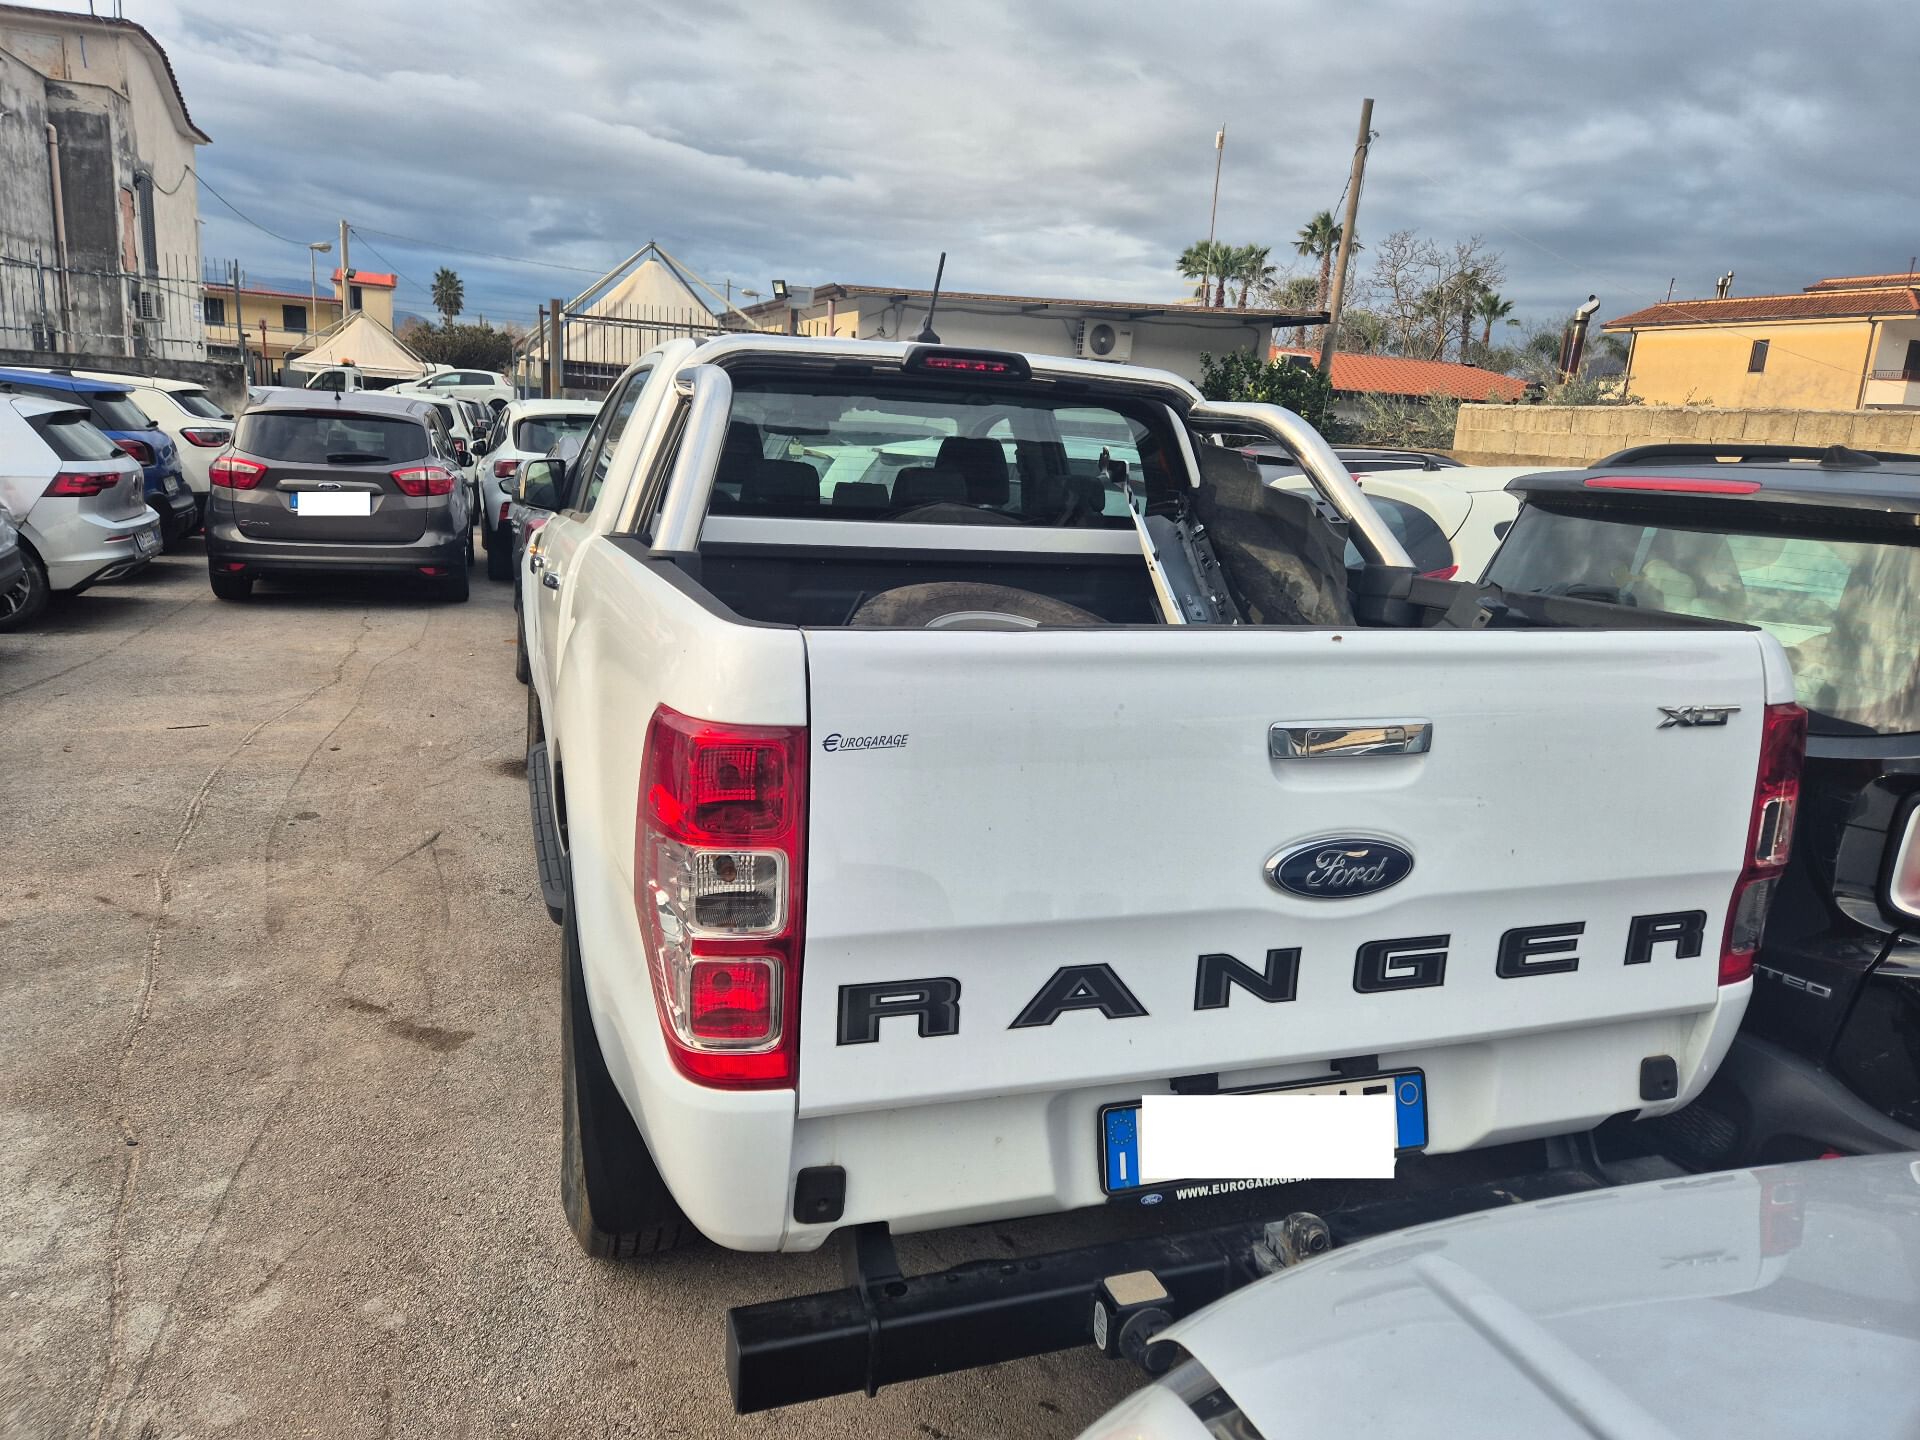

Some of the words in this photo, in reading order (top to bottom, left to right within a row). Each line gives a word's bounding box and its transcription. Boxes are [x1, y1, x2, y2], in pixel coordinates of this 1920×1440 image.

[1656, 704, 1741, 729] XLT
[1306, 849, 1388, 888] Ford
[836, 909, 1708, 1047] RANGER
